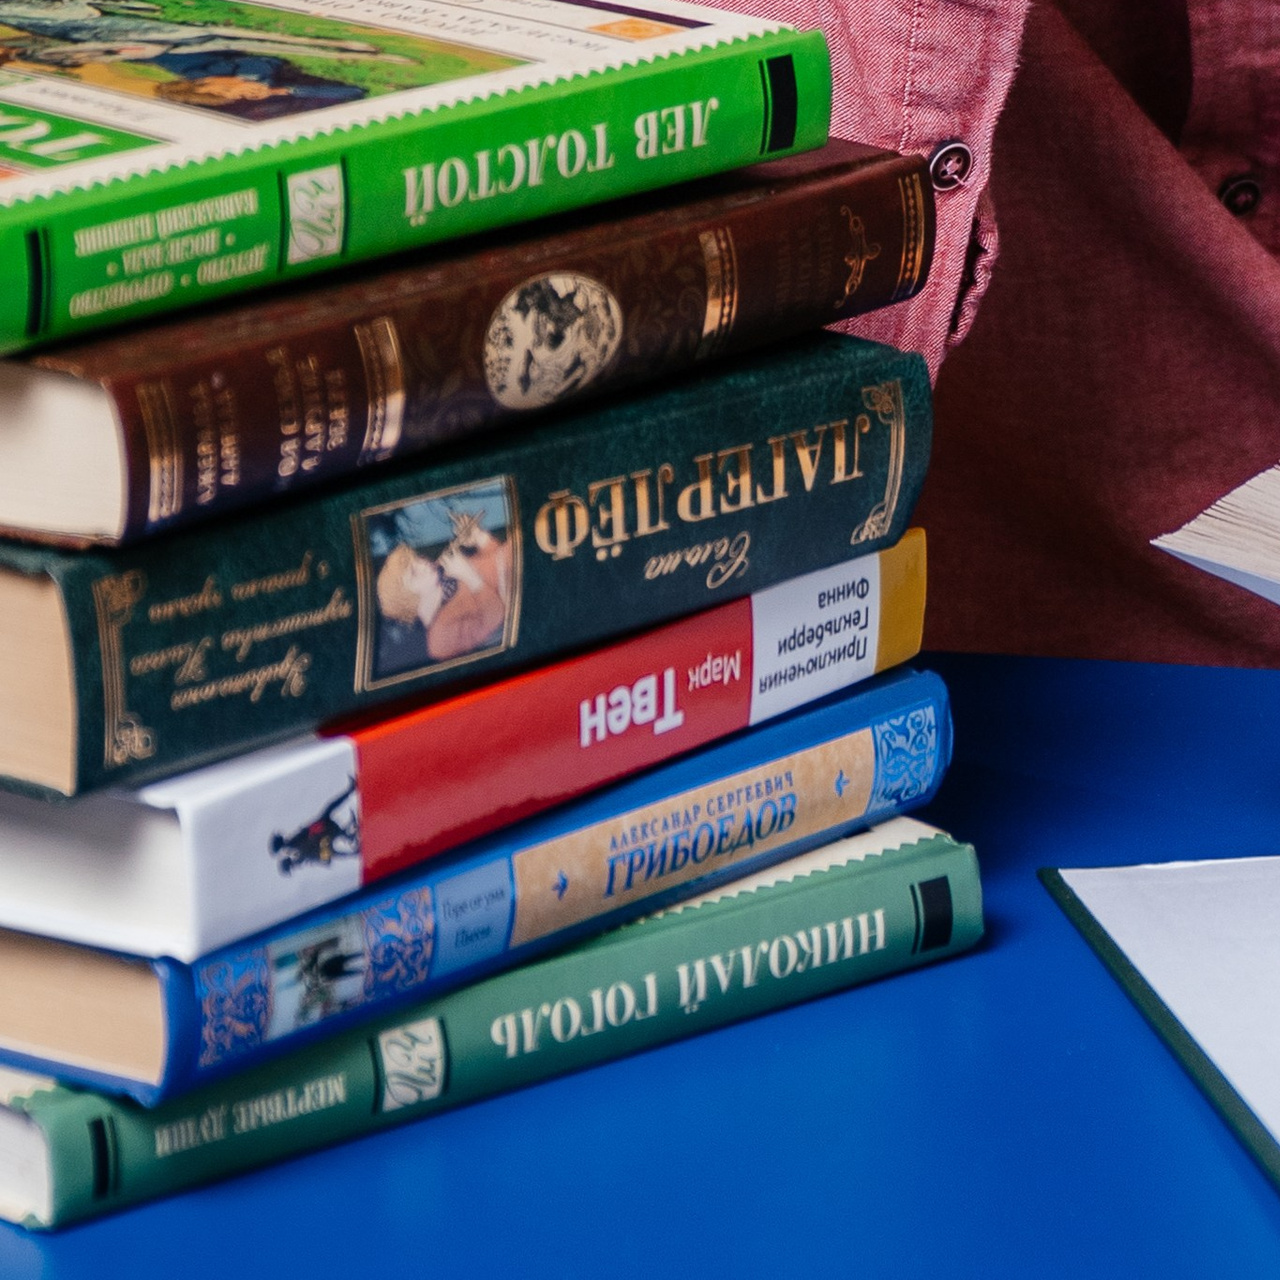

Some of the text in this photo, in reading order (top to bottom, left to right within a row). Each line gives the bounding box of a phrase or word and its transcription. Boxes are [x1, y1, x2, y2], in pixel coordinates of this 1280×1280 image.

[634, 96, 719, 160] ЛЕВ
[401, 122, 616, 227] ТОЛСТОЙ
[534, 413, 871, 562] ЛАГЕРЛЁФ
[777, 606, 869, 657] Гекльберри
[817, 578, 870, 610] Финна
[578, 649, 741, 748] Марк Твен
[759, 636, 868, 694] Приключения
[603, 792, 797, 898] ГРИБОЕДОВ
[610, 770, 794, 851] АЛЕКСАНДР СЕРГЕЕВИЧ
[490, 908, 887, 1059] НИКОЛАЙ ГОГОЛЬ
[154, 1072, 347, 1158] МЕРТВЫЕ ДУШИ
